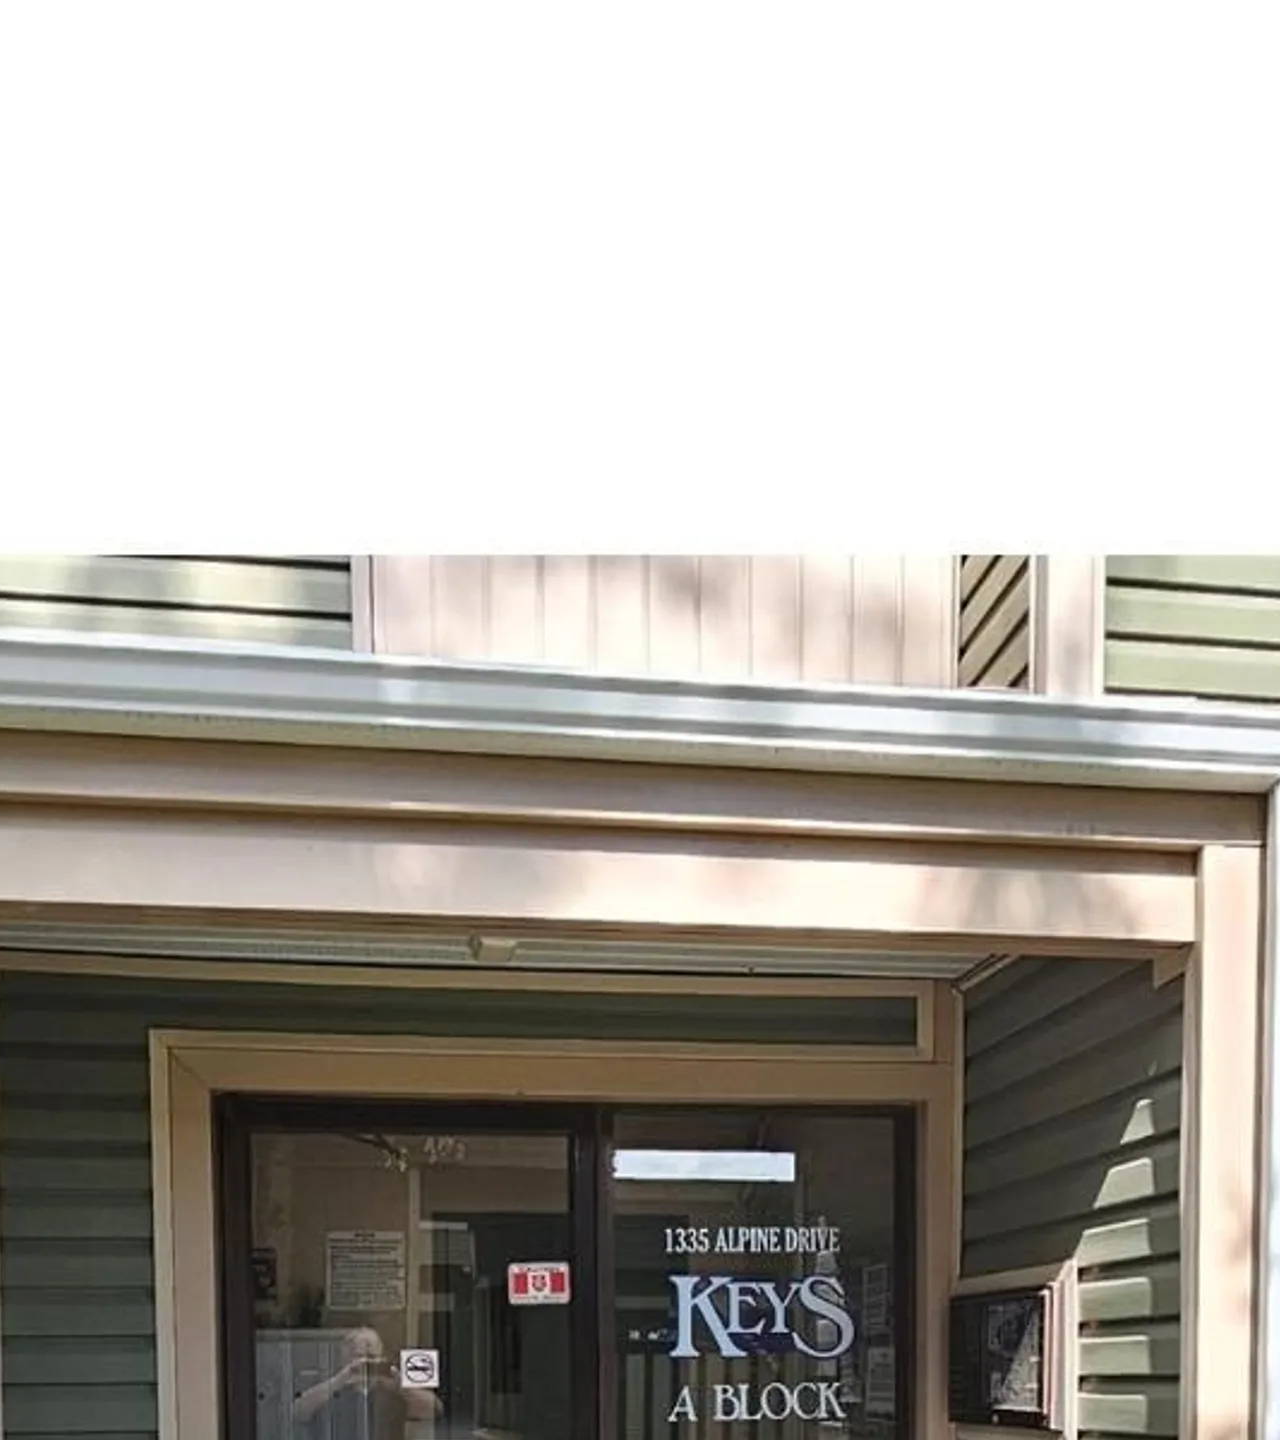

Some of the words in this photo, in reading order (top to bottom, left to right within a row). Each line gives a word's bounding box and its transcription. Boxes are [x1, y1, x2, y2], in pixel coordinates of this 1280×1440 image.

[664, 1228, 710, 1253] 1335
[714, 1227, 781, 1253] ALPINE
[785, 1227, 841, 1253] DRIVE
[670, 1275, 856, 1358] KEYS
[668, 1385, 698, 1422] A
[713, 1382, 847, 1422] BLOCK
